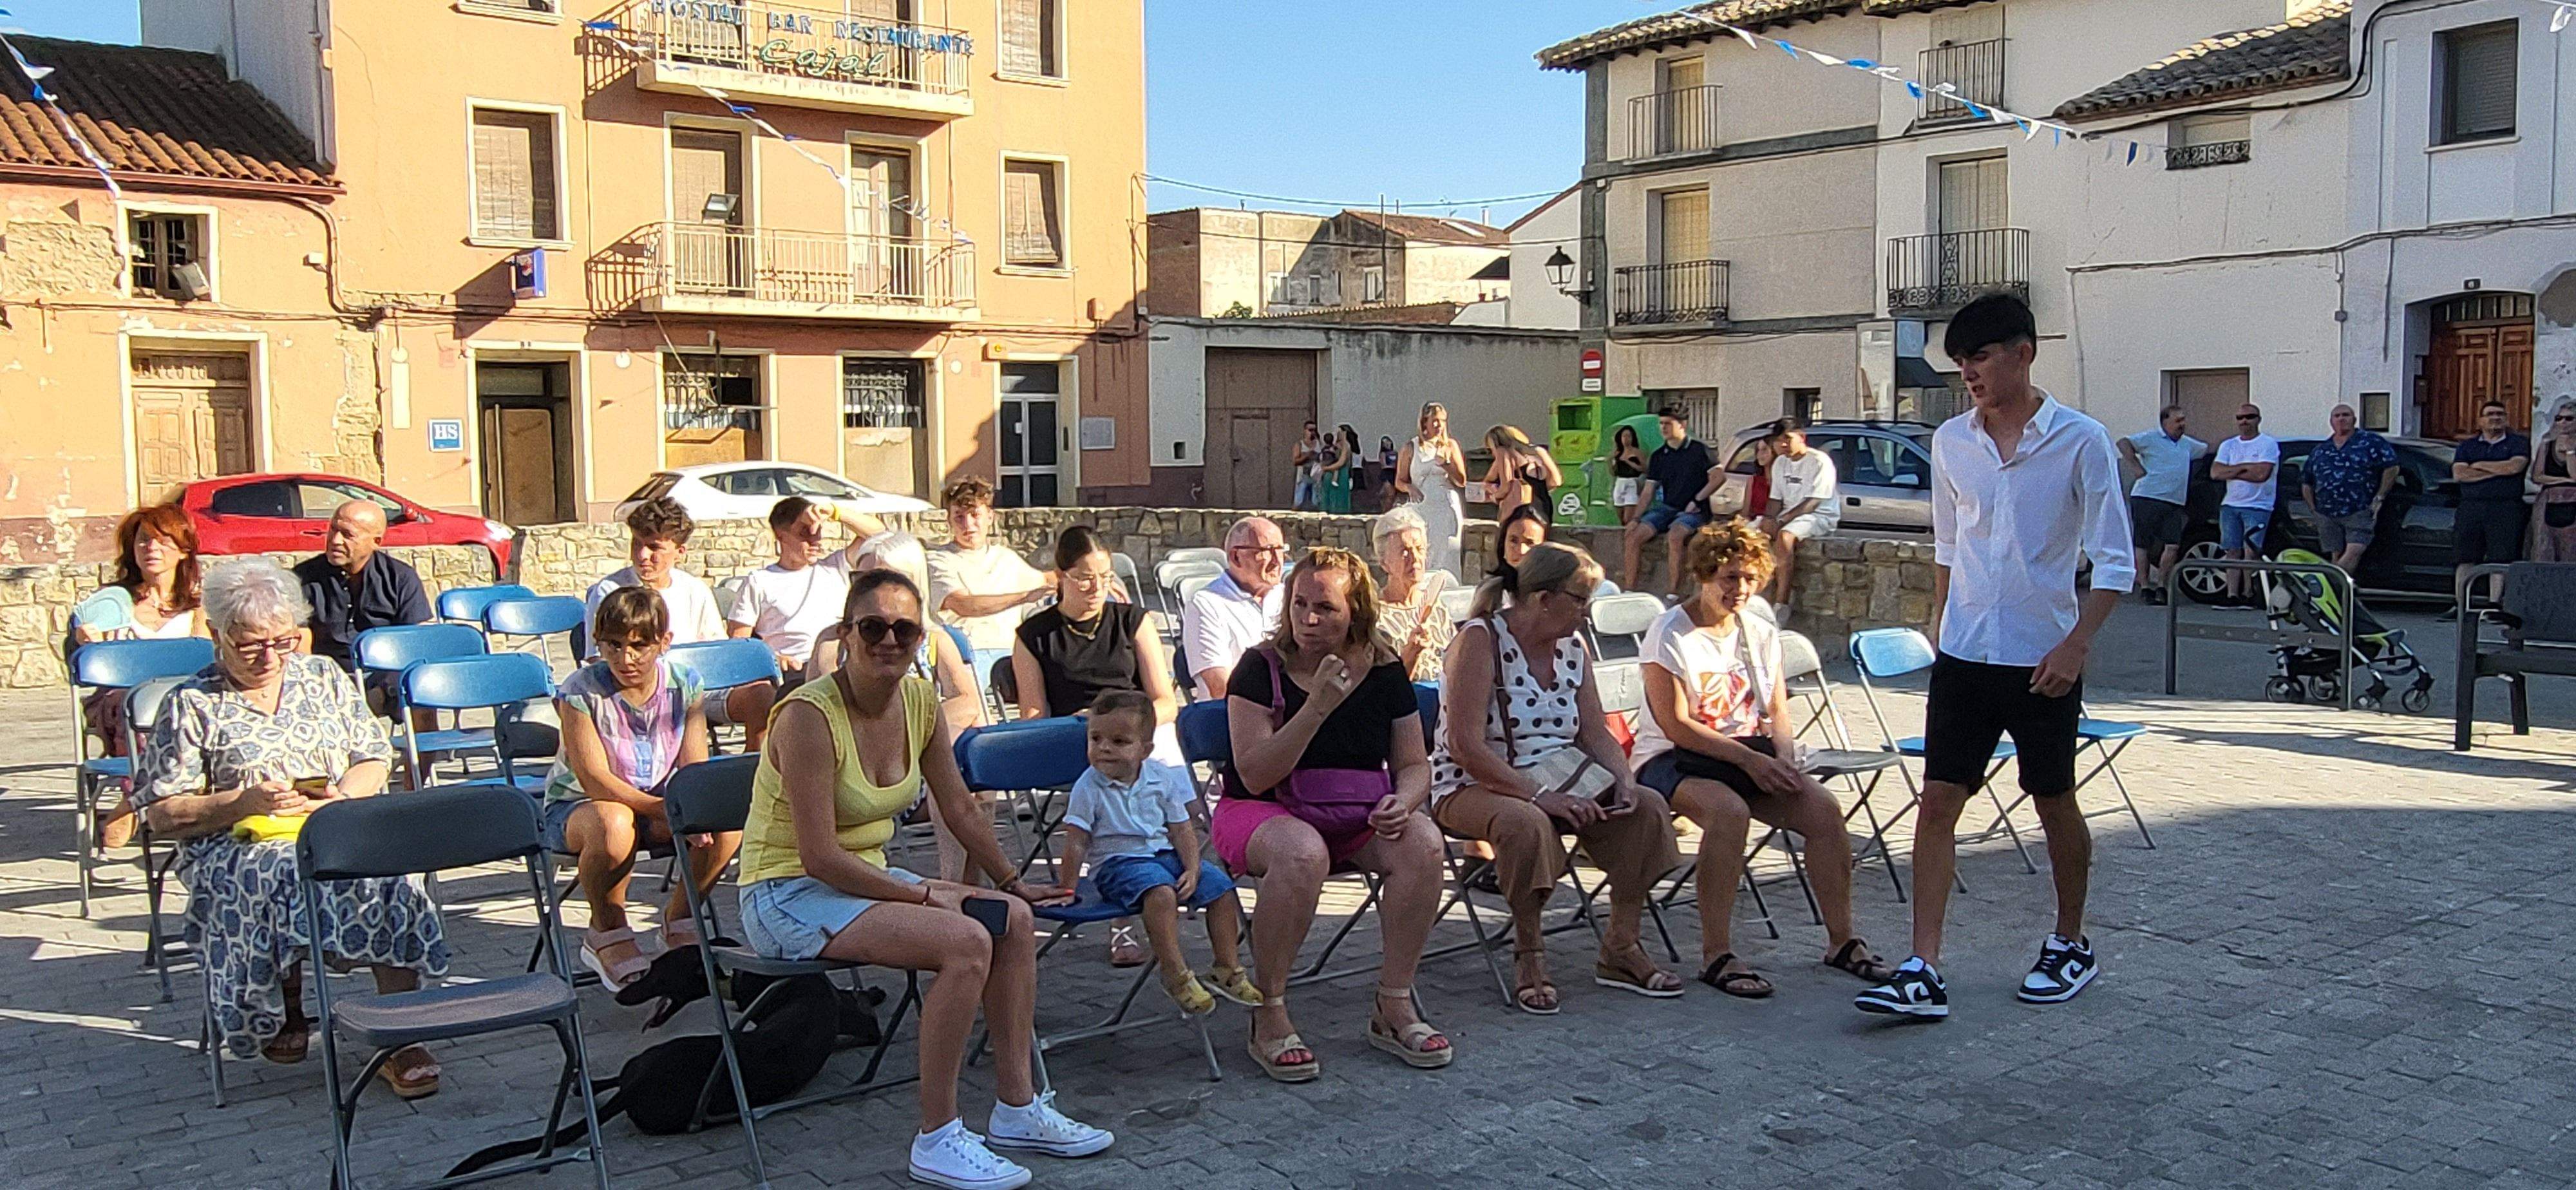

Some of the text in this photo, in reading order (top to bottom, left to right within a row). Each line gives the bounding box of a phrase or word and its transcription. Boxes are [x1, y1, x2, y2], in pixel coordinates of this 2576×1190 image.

[652, 0, 974, 55] HOSTAL BAR RESTAURANTE
[759, 39, 889, 77] Cajal
[433, 424, 458, 440] HS
